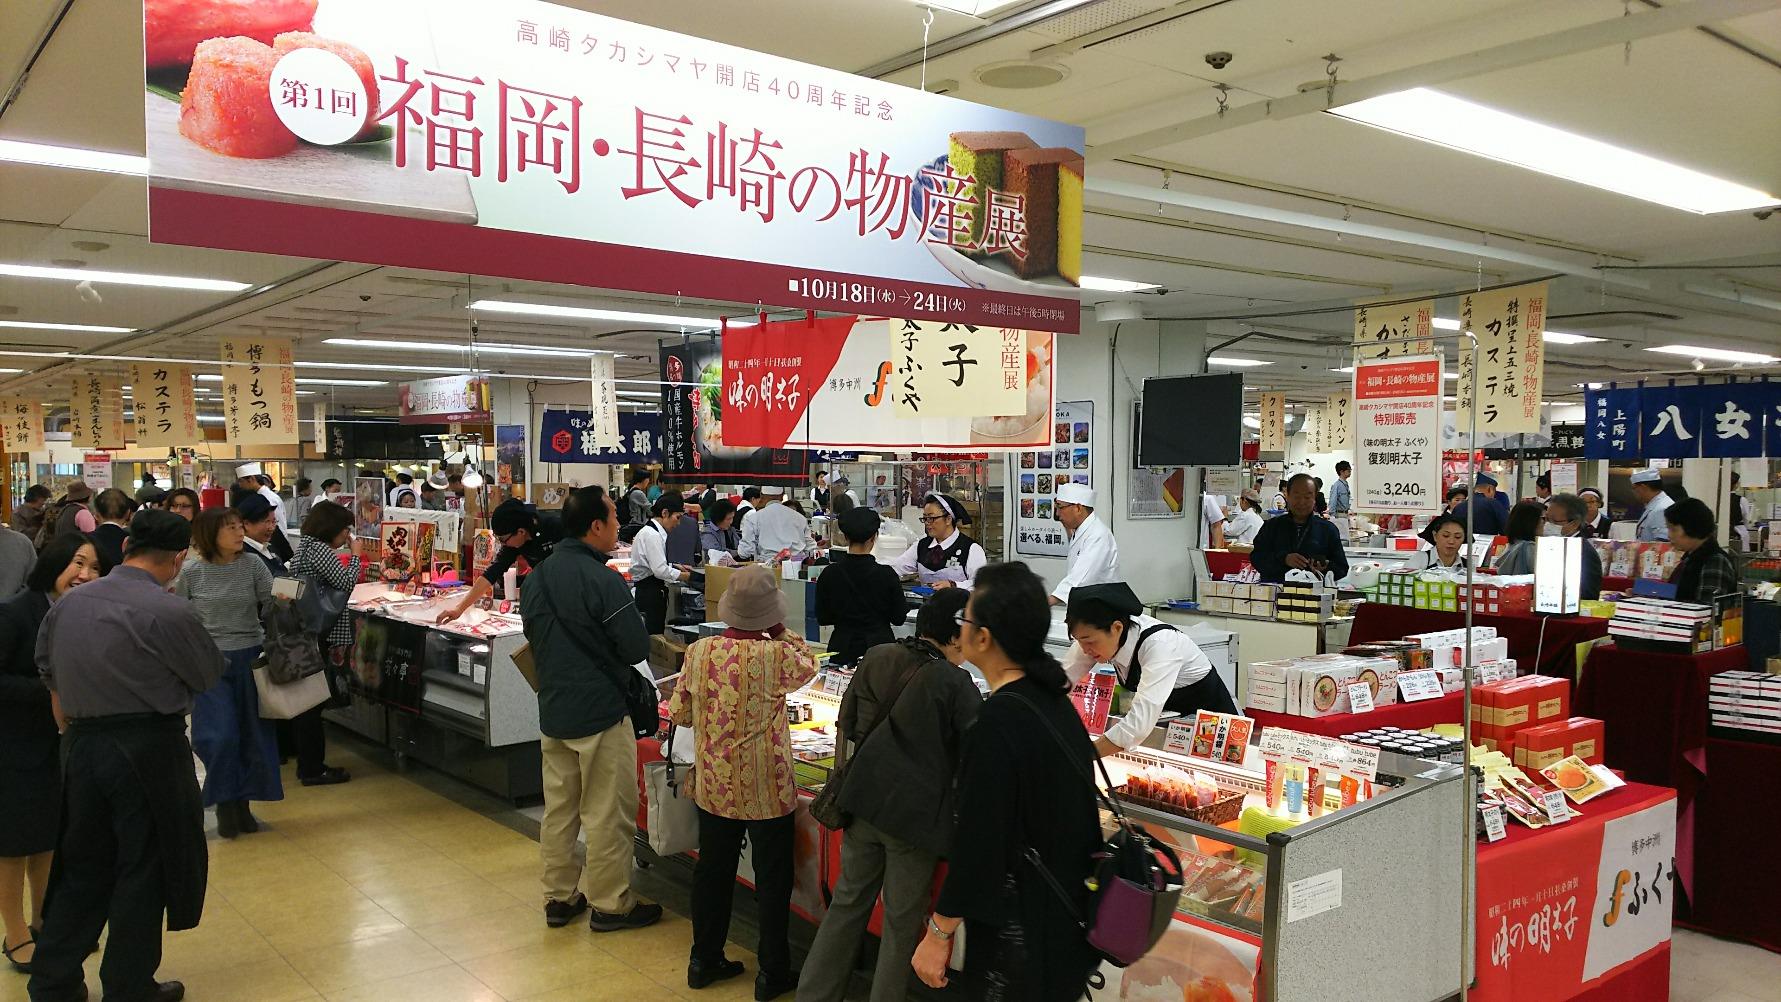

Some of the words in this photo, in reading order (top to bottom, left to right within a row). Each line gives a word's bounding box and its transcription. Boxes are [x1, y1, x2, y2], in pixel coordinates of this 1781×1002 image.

[516, 18, 895, 122] 高崎タカシマヤ開店40周年記念
[279, 77, 358, 118] 第1回
[376, 55, 1031, 260] 福岡・長崎の物産展
[1463, 296, 1473, 331] 長崎県
[1484, 318, 1502, 423] カステラ
[1523, 297, 1543, 418] 福岡・長崎の物産展
[153, 368, 172, 433] カステラ
[246, 344, 272, 431] 博多もつ鍋
[1336, 397, 1347, 444] カレーパン
[1374, 412, 1417, 426] 特別販売
[1597, 398, 1607, 440] 福岡八女
[1612, 409, 1627, 451] 上陽町
[1650, 400, 1781, 440] 八女
[1368, 452, 1423, 466] 復刻明太子
[1383, 482, 1427, 498] 3,240円
[1020, 532, 1065, 546] 選べる、福岡。
